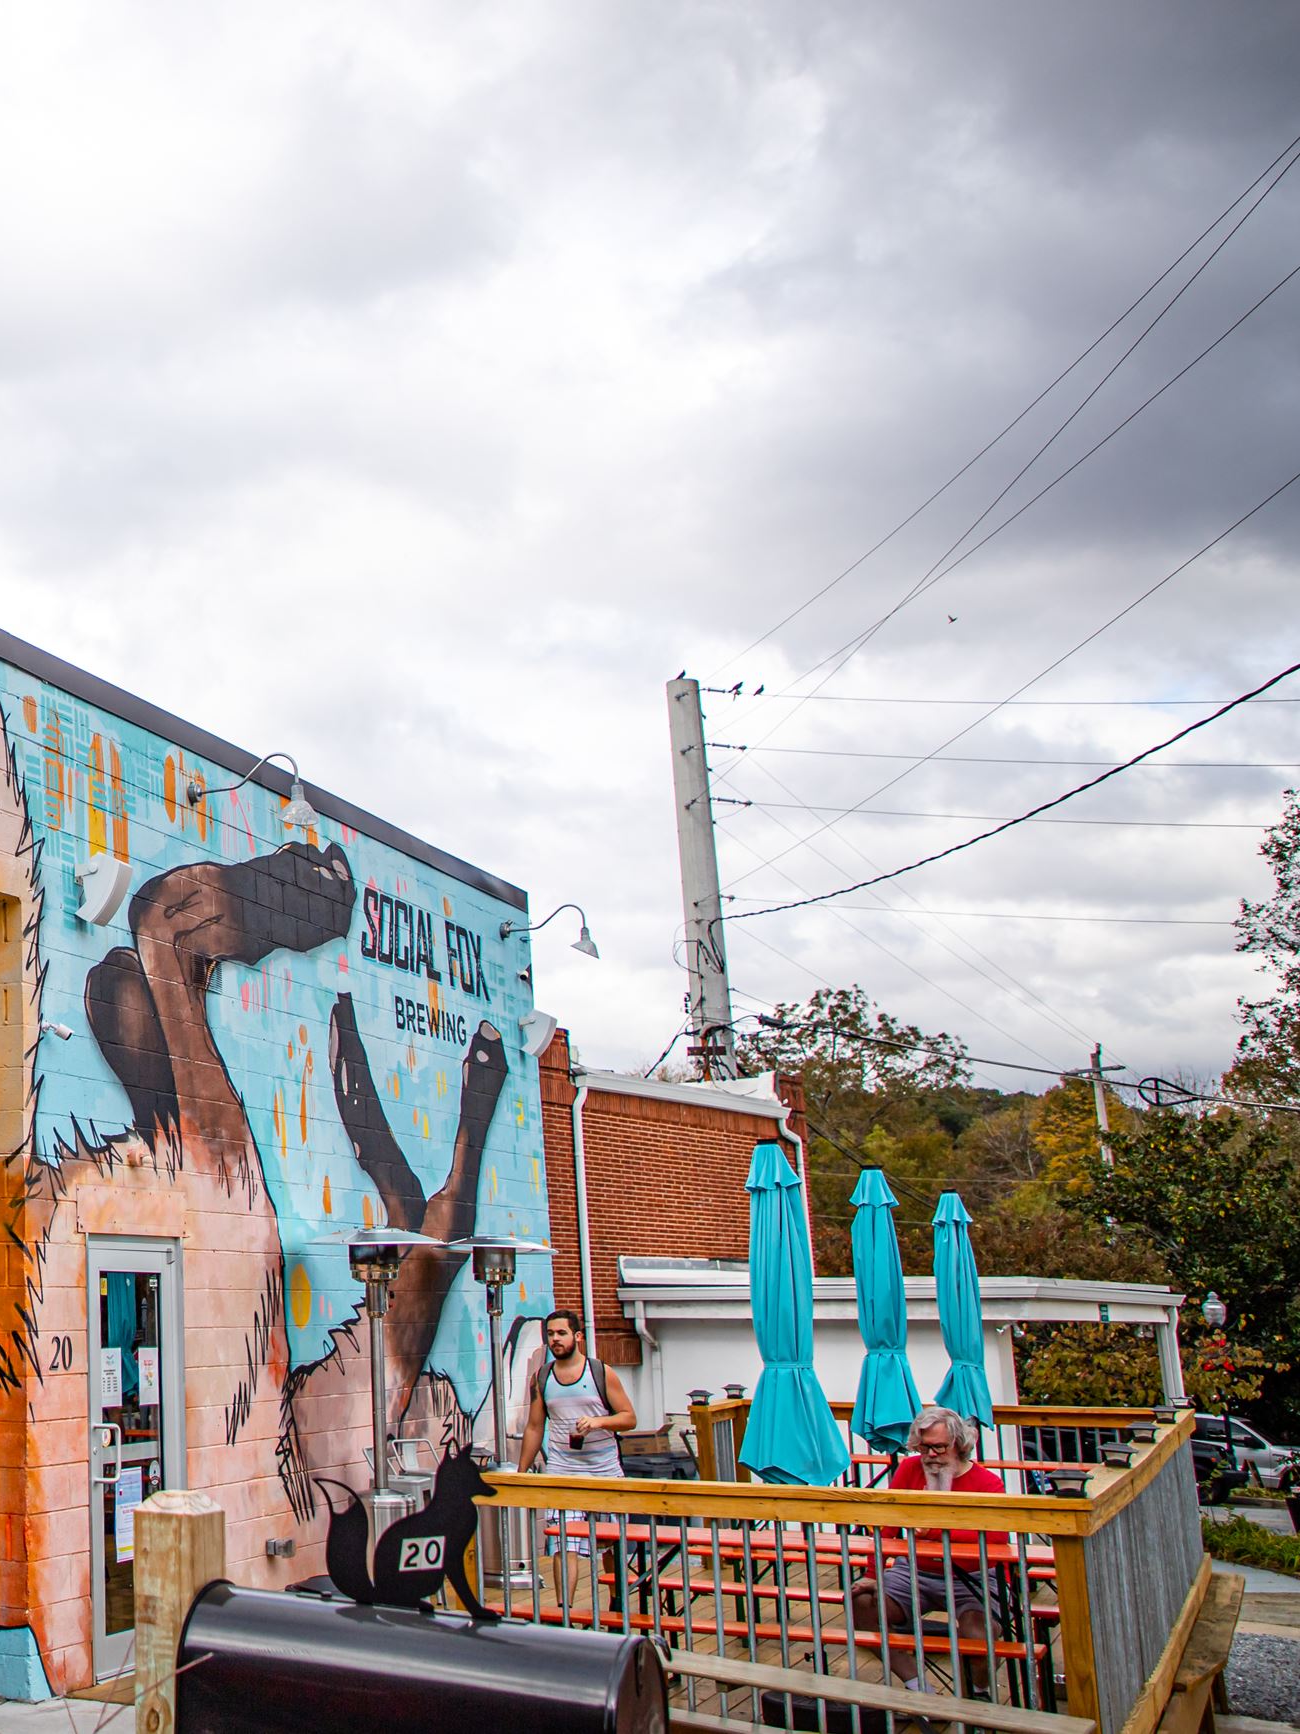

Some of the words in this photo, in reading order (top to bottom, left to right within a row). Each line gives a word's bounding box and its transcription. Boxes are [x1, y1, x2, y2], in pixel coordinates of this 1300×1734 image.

[360, 887, 442, 983] SOCIAL
[444, 919, 491, 1002] FOX
[394, 995, 467, 1047] BREWING
[49, 1335, 73, 1371] 20
[403, 1540, 441, 1568] 20
